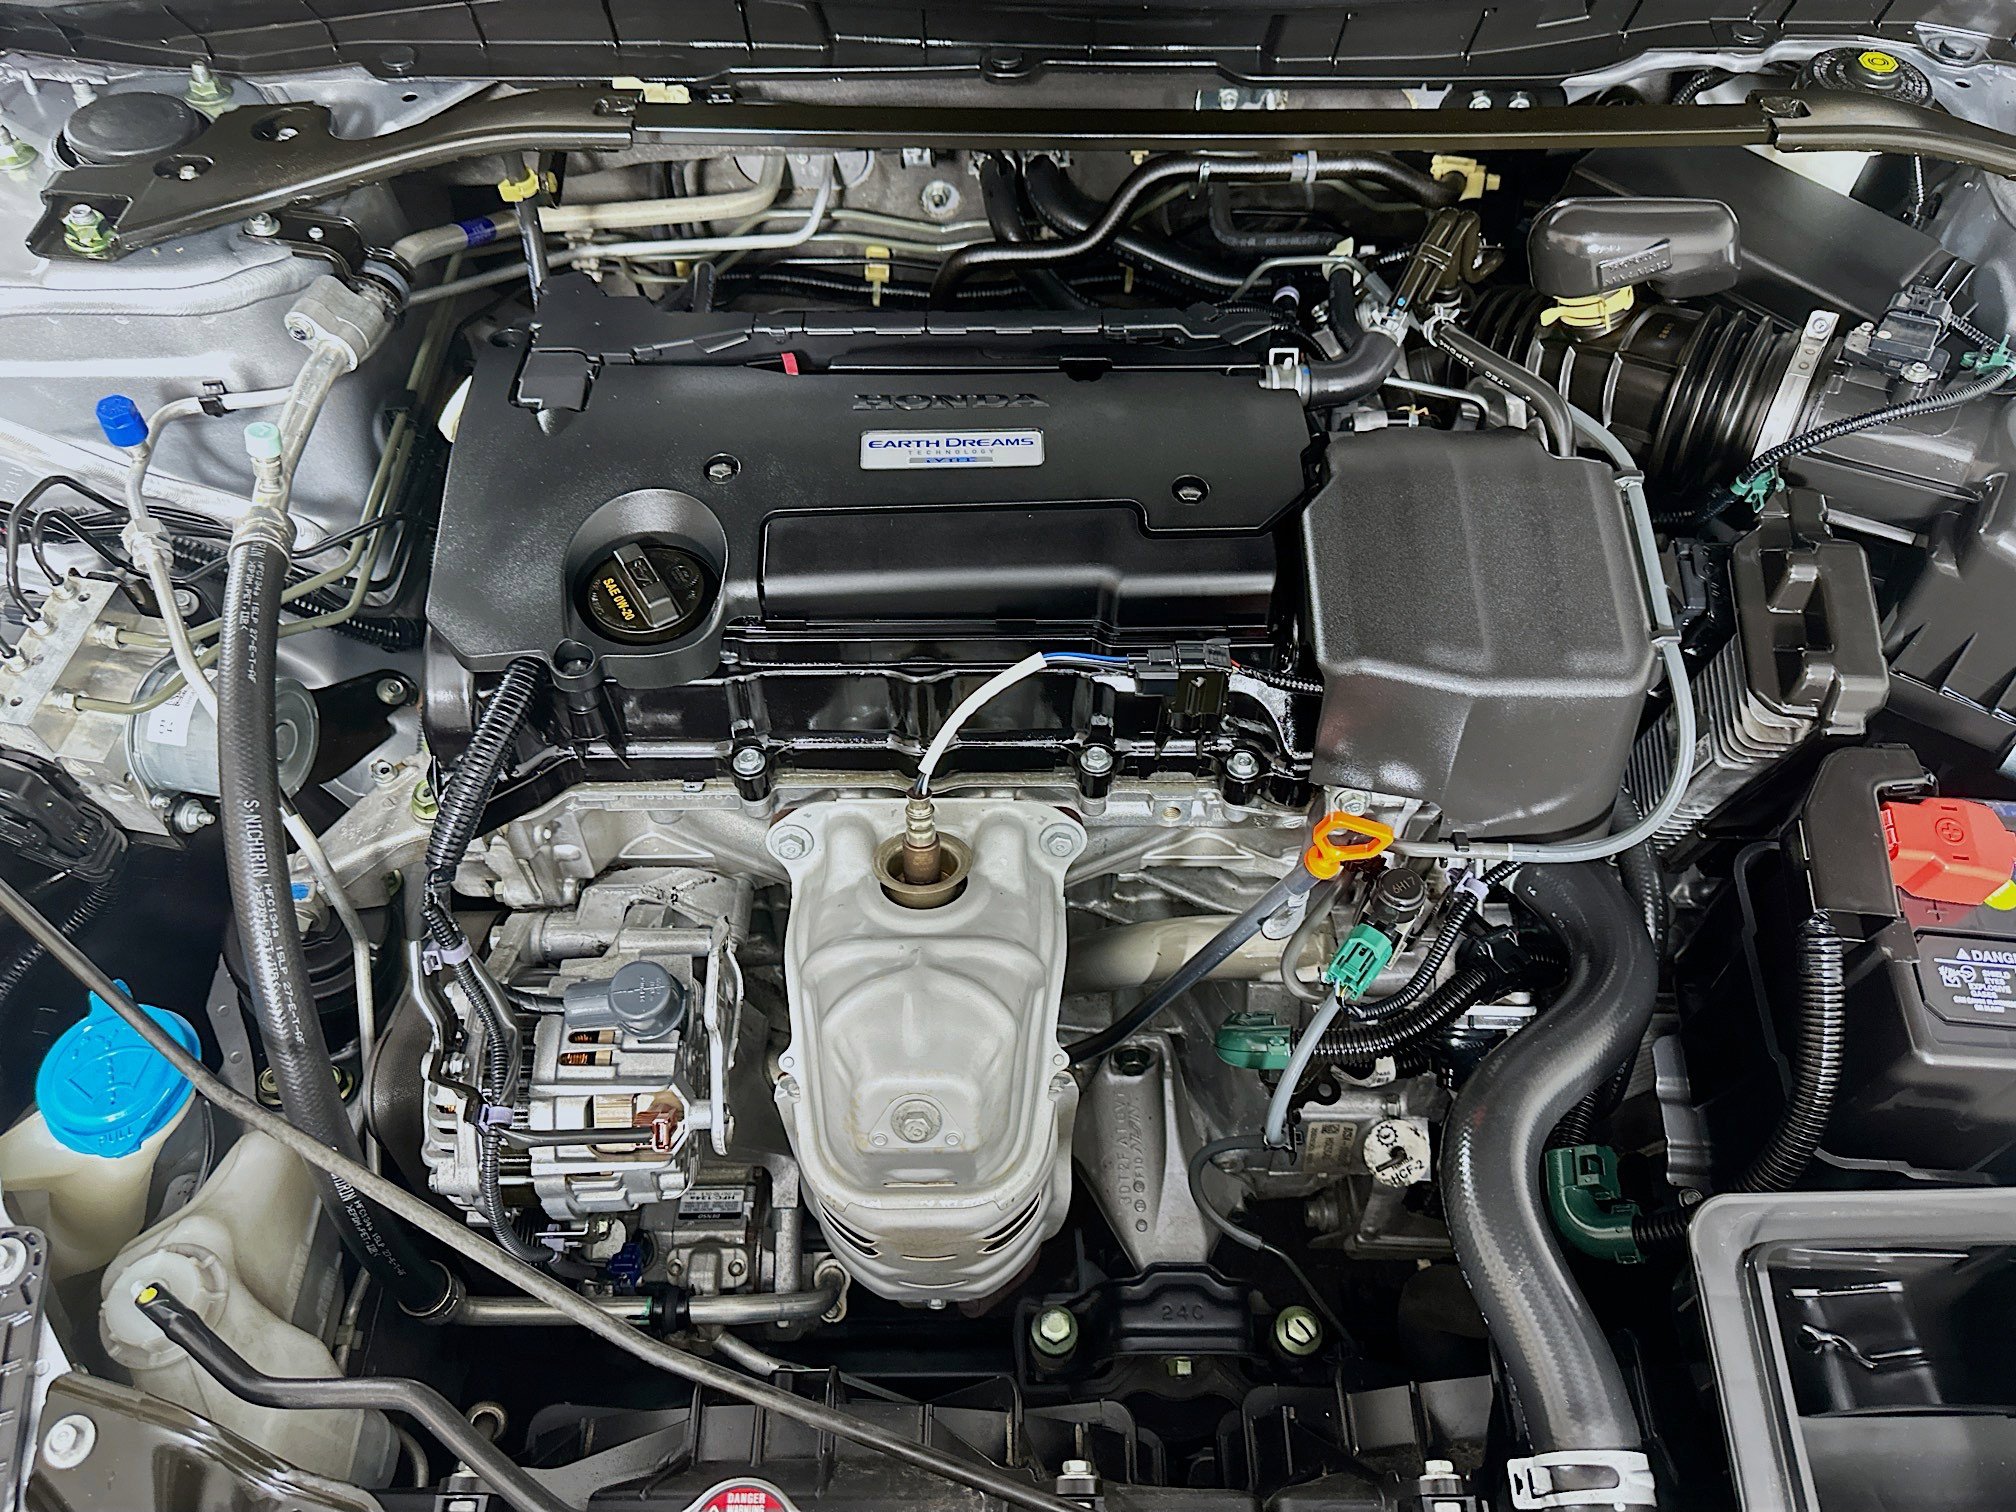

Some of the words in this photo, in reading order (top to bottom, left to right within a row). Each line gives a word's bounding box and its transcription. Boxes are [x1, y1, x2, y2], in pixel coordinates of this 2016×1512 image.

[853, 393, 1050, 410] HONDA
[868, 440, 940, 449] EARTH
[945, 437, 1034, 448] DREAMS
[603, 577, 621, 597] SAE
[613, 594, 635, 621] 0W-20
[1392, 876, 1415, 894] 6H17
[99, 1126, 134, 1147] PULL
[1391, 1159, 1424, 1184] HCF-2
[727, 1492, 766, 1504] DANGER
